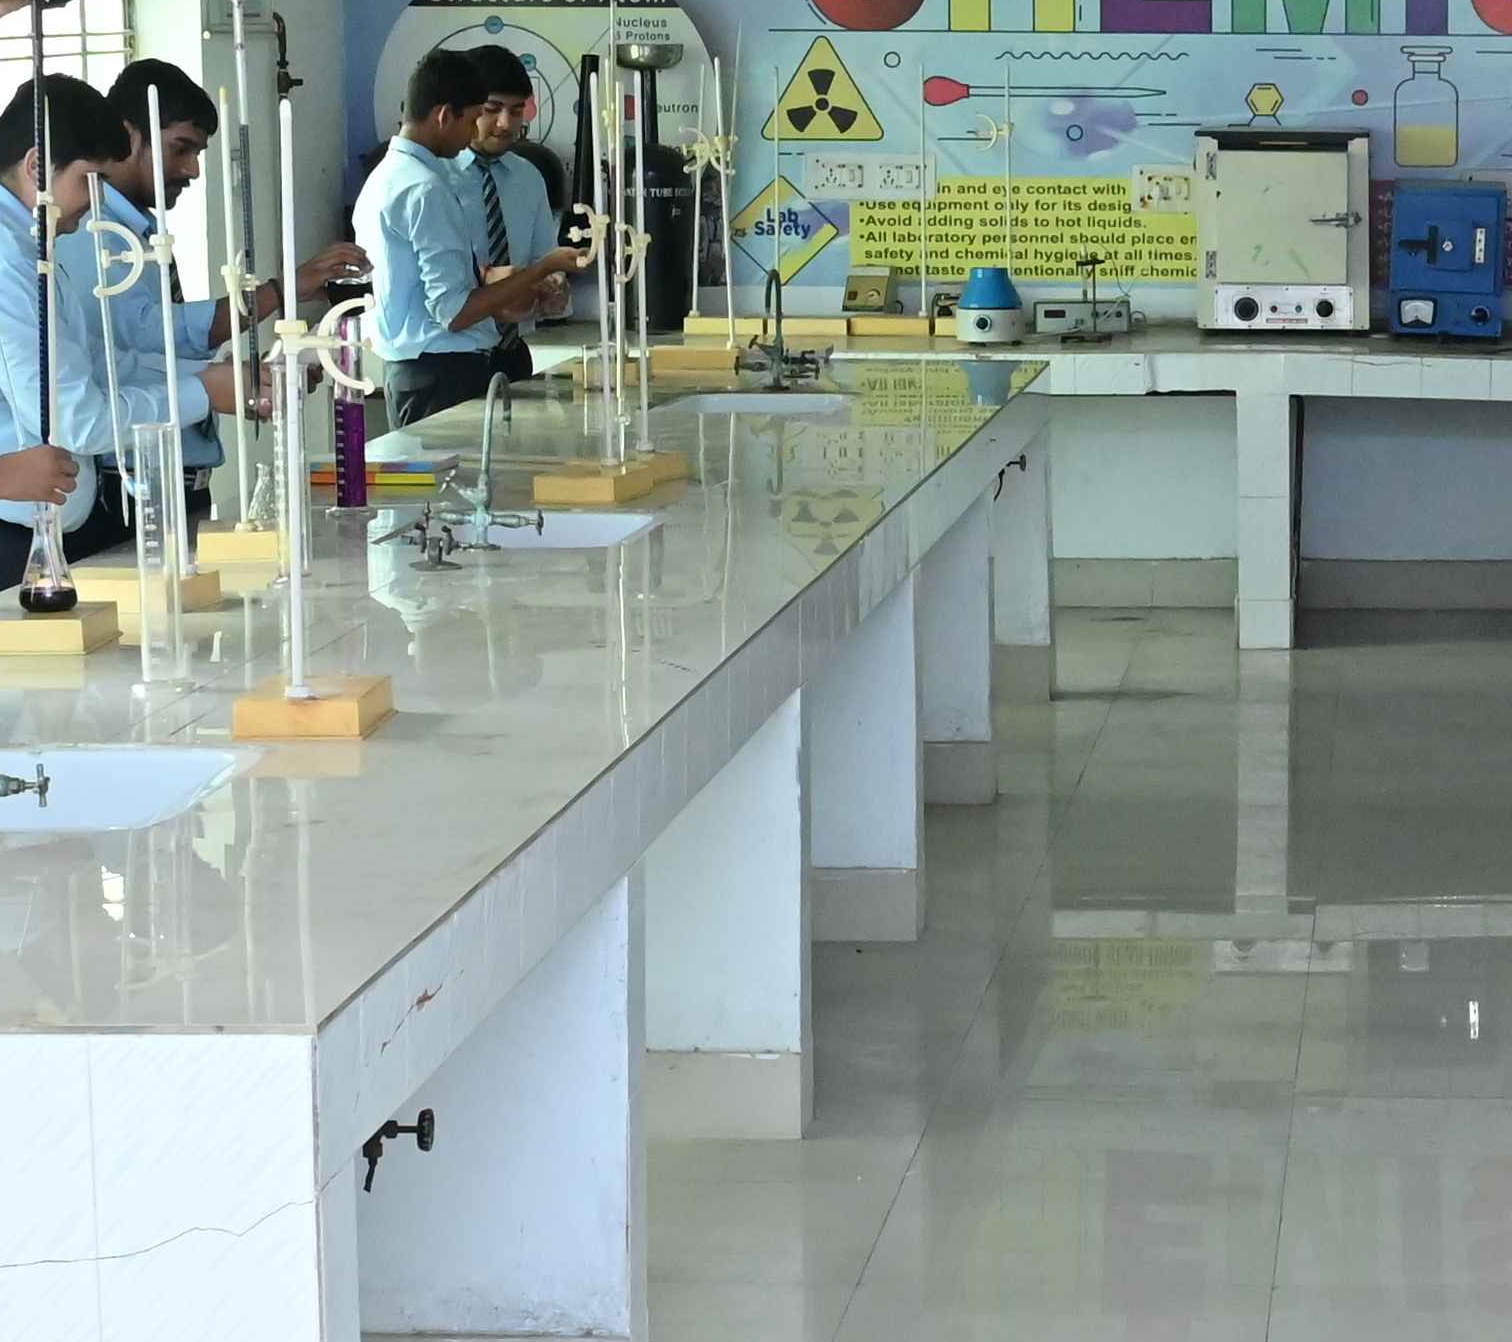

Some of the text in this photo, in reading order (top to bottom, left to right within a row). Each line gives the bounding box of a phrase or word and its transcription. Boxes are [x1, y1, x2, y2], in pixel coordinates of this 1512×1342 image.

[625, 30, 670, 41] Protons
[657, 102, 698, 113] eutron
[956, 182, 1126, 197] and eye contact with
[901, 200, 990, 212] equipment
[994, 199, 1029, 213] only
[1035, 200, 1058, 211] for
[1063, 200, 1081, 211] its
[1088, 200, 1132, 213] desig
[766, 208, 798, 223] Lab
[865, 214, 912, 226] Avoid
[979, 215, 1029, 227] solids
[1034, 218, 1050, 228] to
[1055, 216, 1082, 228] hot
[1087, 216, 1147, 229] liquids.
[865, 231, 887, 243] All
[982, 233, 1064, 246] personnel
[1069, 232, 1125, 244] should
[1131, 233, 1174, 246] place
[864, 247, 914, 261] safety
[1034, 248, 1099, 263] hygiee
[1103, 250, 1119, 260] at
[1124, 249, 1142, 260] all
[1148, 249, 1198, 261] times.
[895, 264, 1197, 277] not taste entionally sniff chemic
